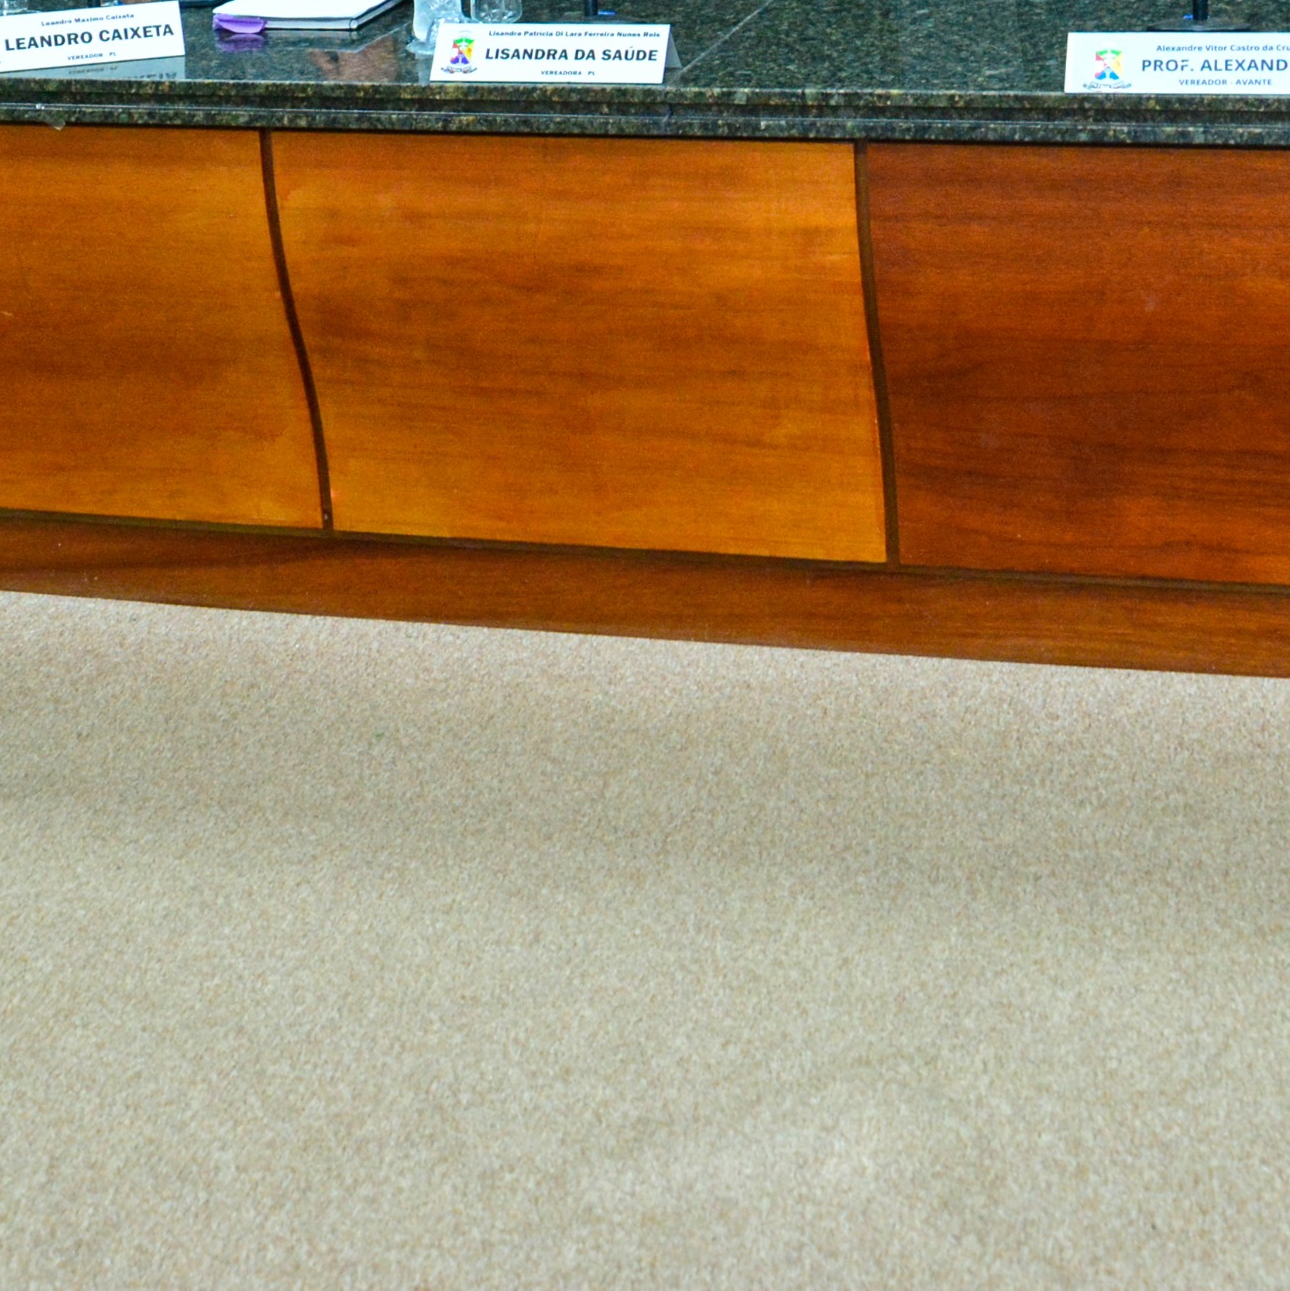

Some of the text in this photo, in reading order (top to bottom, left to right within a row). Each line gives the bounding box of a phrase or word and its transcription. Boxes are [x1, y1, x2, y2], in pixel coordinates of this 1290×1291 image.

[41, 19, 73, 27] Leandro
[105, 13, 135, 21] Caixeta
[4, 24, 174, 52] LEANDRO CAIXETA
[485, 45, 659, 61] LISANDRA DA SAÚDE
[1156, 44, 1203, 52] Alexandre
[67, 53, 104, 61] VEREADOR
[1142, 59, 1194, 72] PROF.
